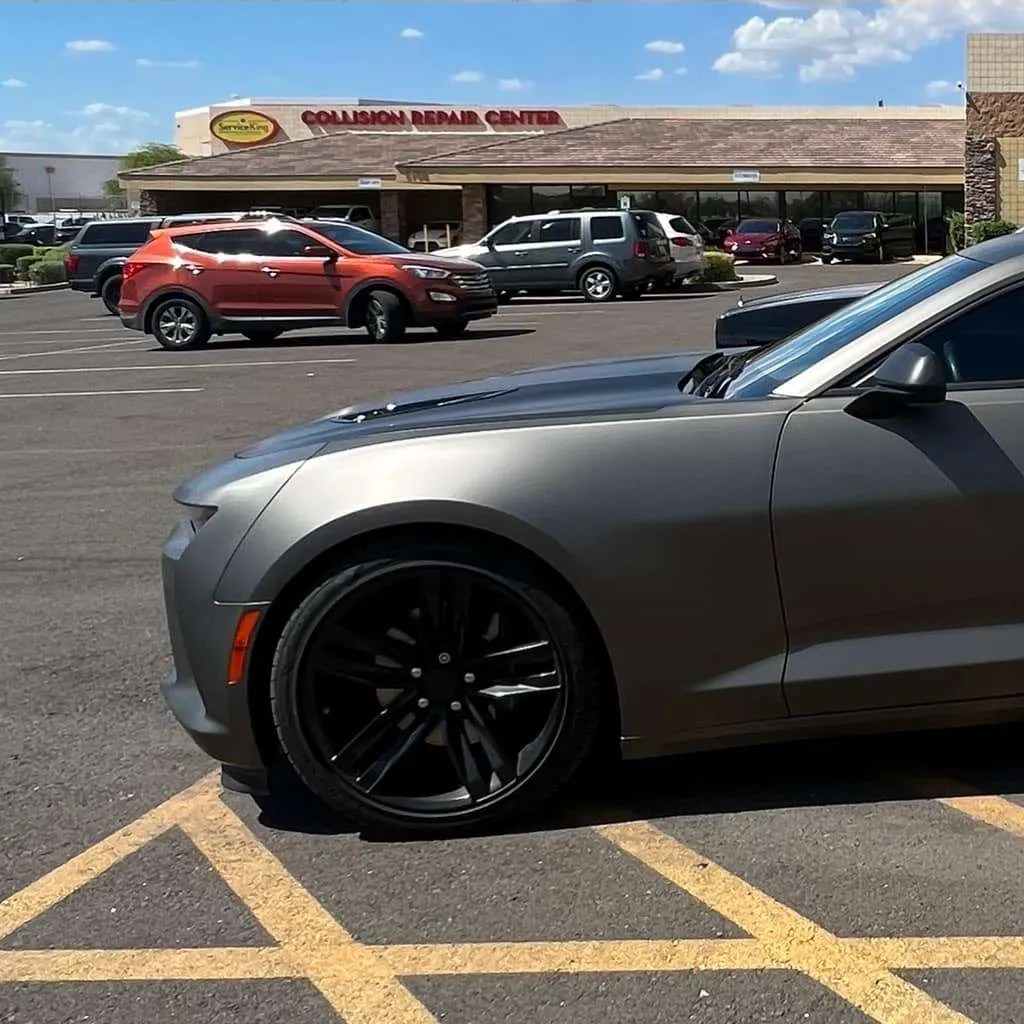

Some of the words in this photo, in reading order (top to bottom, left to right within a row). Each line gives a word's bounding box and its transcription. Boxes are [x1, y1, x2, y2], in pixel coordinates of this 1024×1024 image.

[301, 110, 405, 125] COLLISION
[411, 110, 480, 125] REPAIR
[485, 110, 561, 125] CENTER
